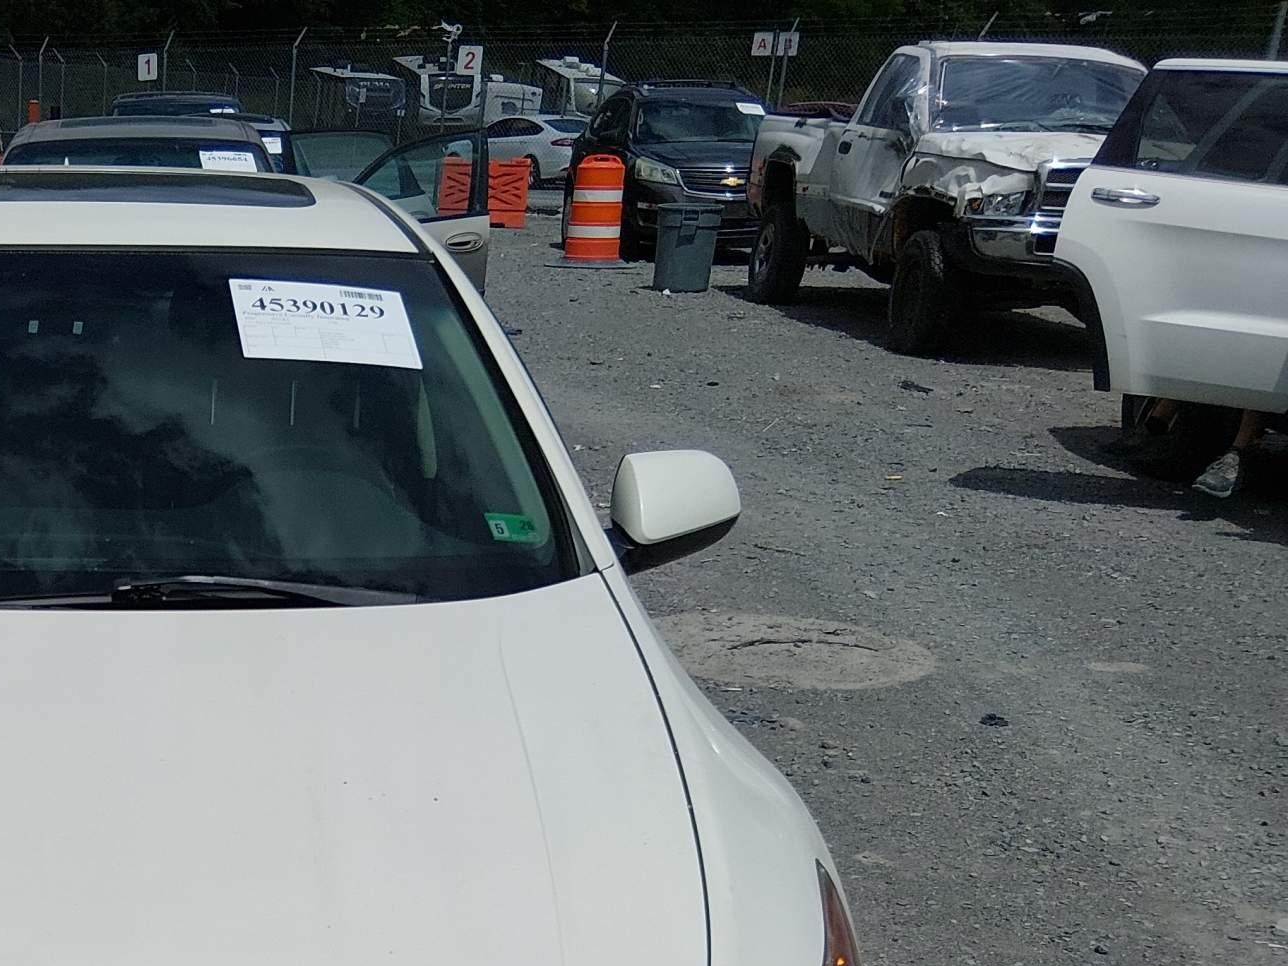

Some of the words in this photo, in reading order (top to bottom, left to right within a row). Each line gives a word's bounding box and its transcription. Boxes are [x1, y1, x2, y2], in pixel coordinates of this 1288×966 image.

[757, 38, 766, 50] A
[144, 58, 151, 75] 1
[463, 51, 475, 70] 2
[251, 297, 385, 319] 45390129
[494, 522, 505, 535] 5
